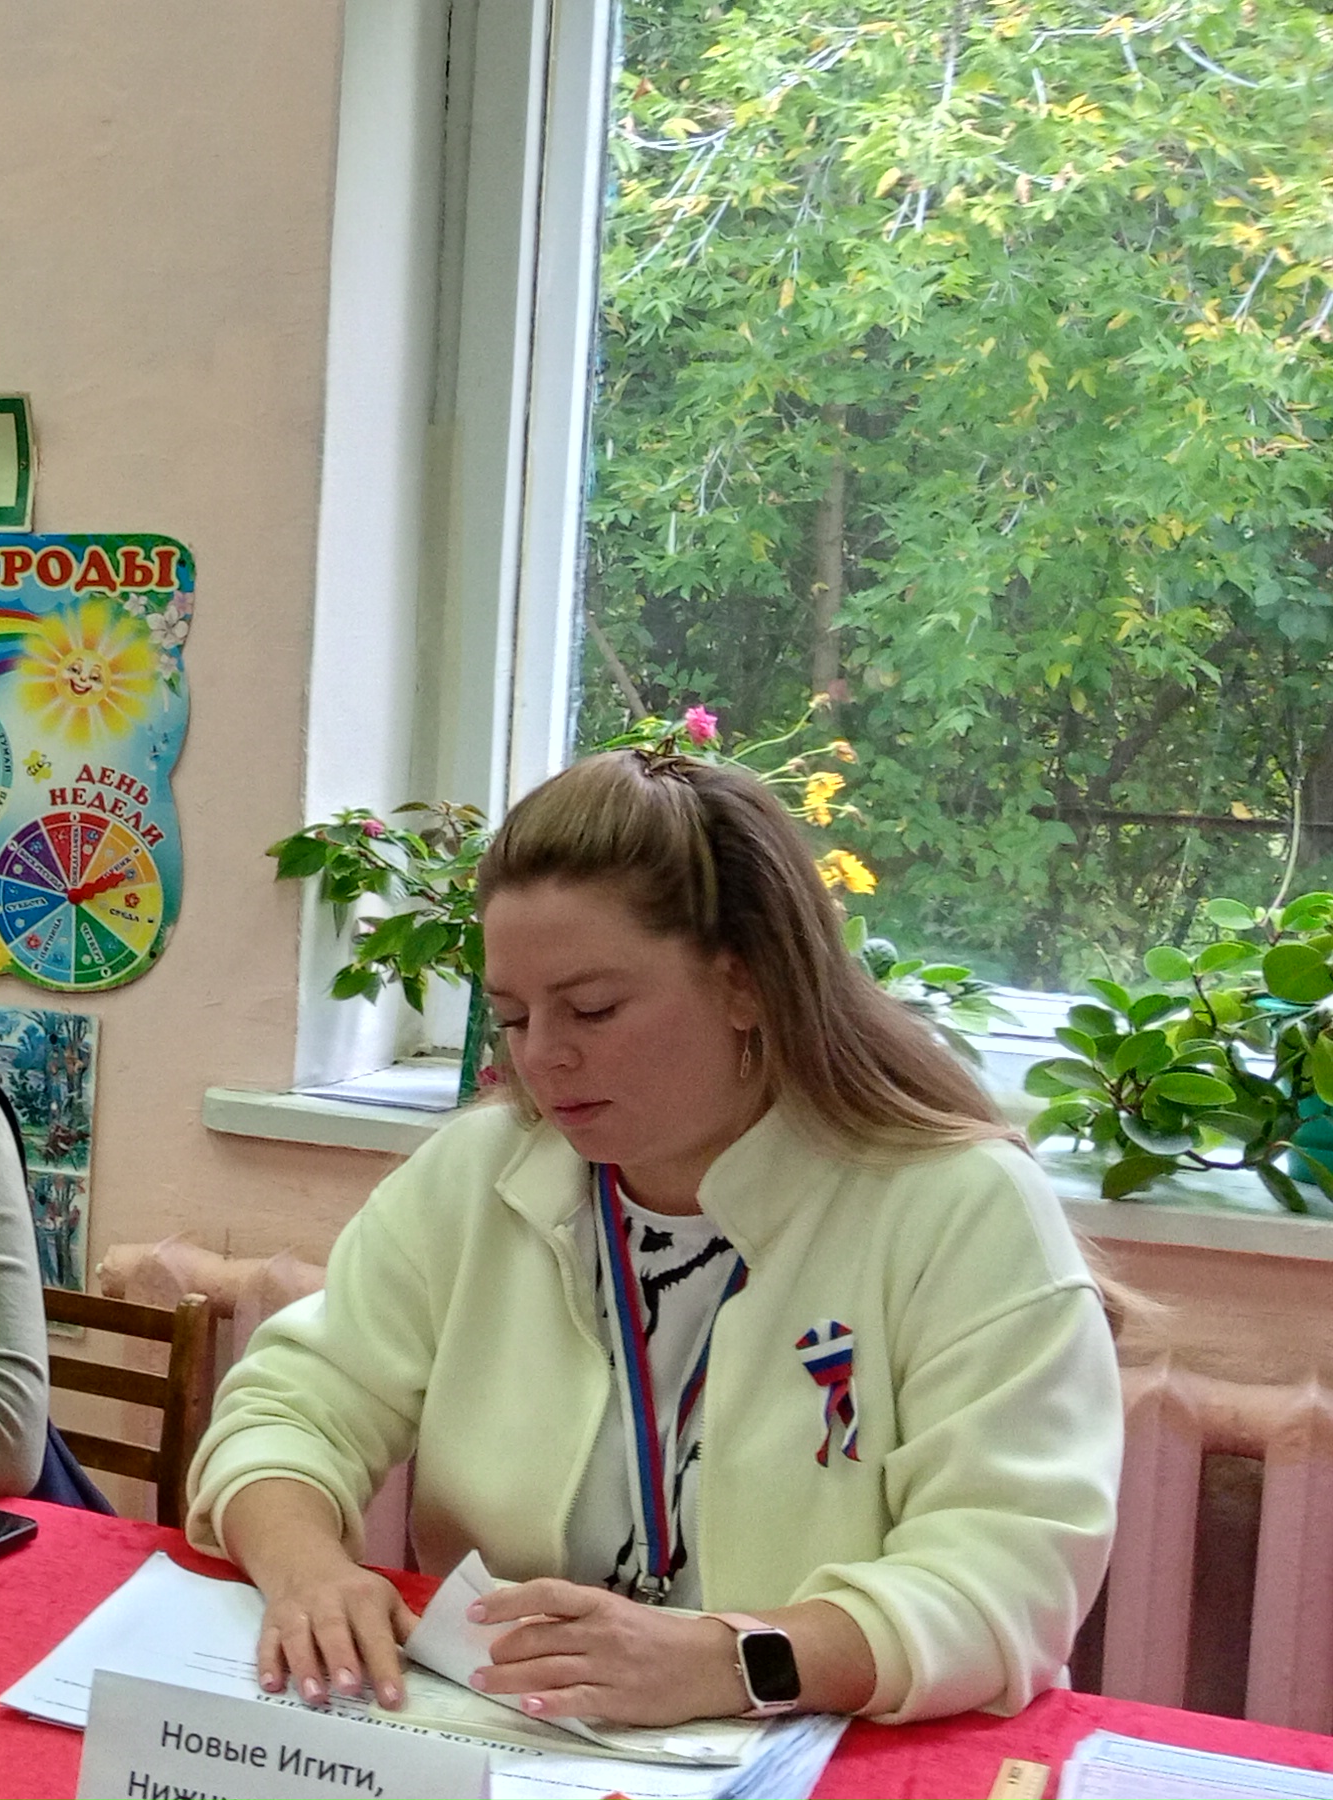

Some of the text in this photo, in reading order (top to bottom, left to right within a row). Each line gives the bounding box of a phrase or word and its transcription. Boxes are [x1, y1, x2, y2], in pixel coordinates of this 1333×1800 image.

[0, 732, 11, 774] ТУМАН
[75, 763, 151, 806] ДЕНЬ
[49, 787, 165, 849] НЕДЕЛИ
[160, 1720, 384, 1797] Новые Игити,
